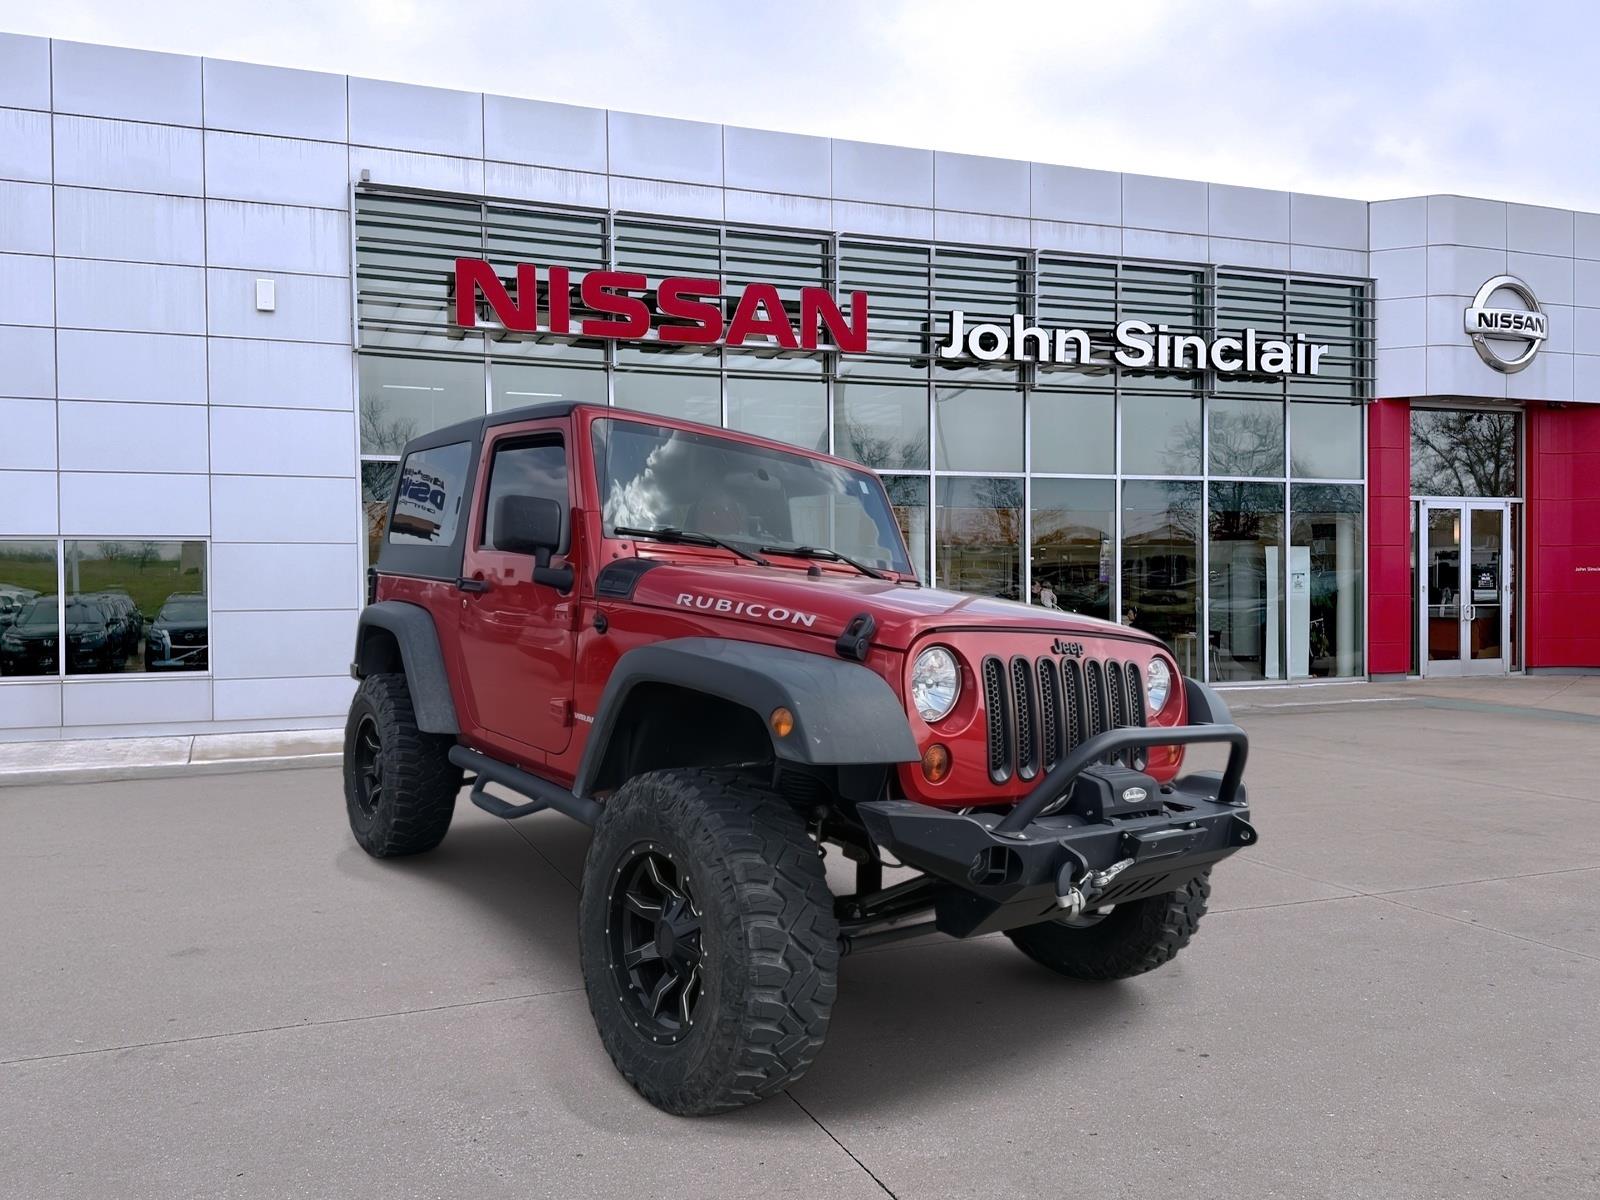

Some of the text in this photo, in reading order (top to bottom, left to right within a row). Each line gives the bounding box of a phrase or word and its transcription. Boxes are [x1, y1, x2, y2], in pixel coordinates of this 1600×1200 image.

[455, 257, 868, 353] NISSAN
[1477, 312, 1545, 334] NISSAN
[940, 310, 1329, 375] John Sinclair
[676, 593, 817, 627] RUBICON
[1050, 637, 1084, 658] Jeep
